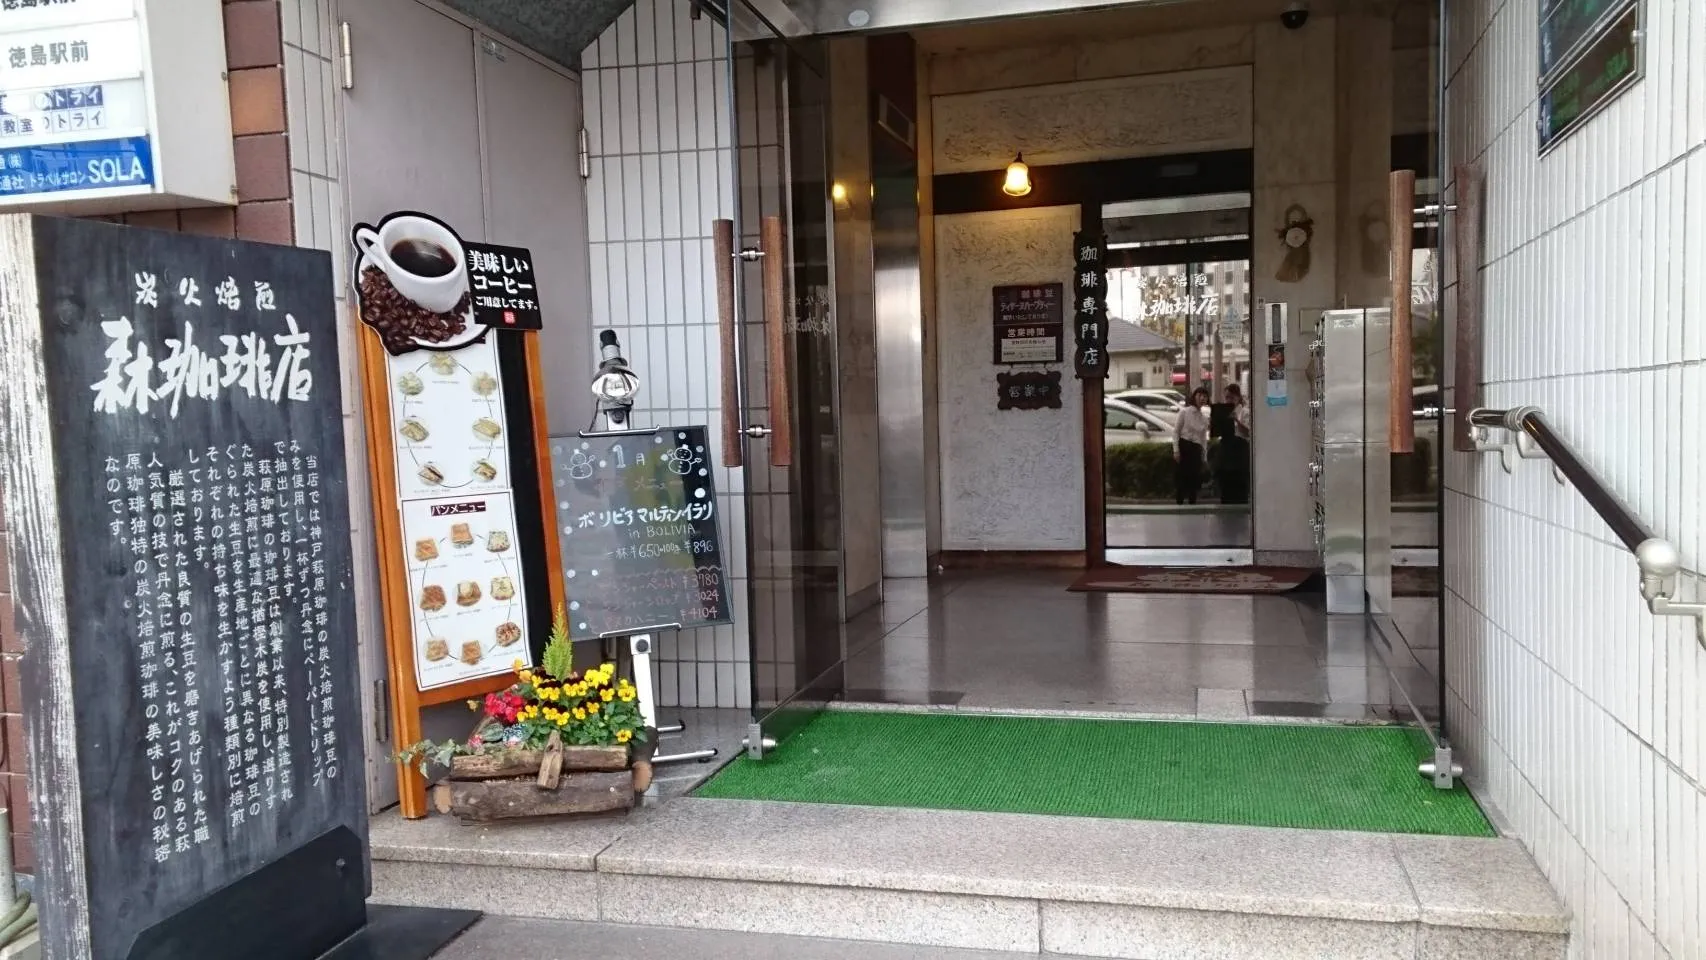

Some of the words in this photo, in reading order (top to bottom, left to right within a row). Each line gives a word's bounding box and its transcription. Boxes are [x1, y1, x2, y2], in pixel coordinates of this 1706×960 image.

[9, 40, 89, 68] 徳島駅前
[30, 170, 86, 188] トラベルサロン
[88, 155, 146, 184] SOLA
[468, 250, 529, 273] 美味しい
[135, 271, 276, 311] 炭火焙煎
[473, 275, 533, 294] コーヒー
[475, 296, 538, 311] ご用意してます。
[1079, 246, 1099, 366] 珈琲専門店
[1007, 327, 1046, 338] 営業時間
[90, 312, 313, 420] 森珈琲店
[105, 457, 127, 544] なのです。
[188, 449, 210, 568] しております。
[431, 503, 486, 516] パンメニュー
[646, 523, 697, 539] BOLIVIA
